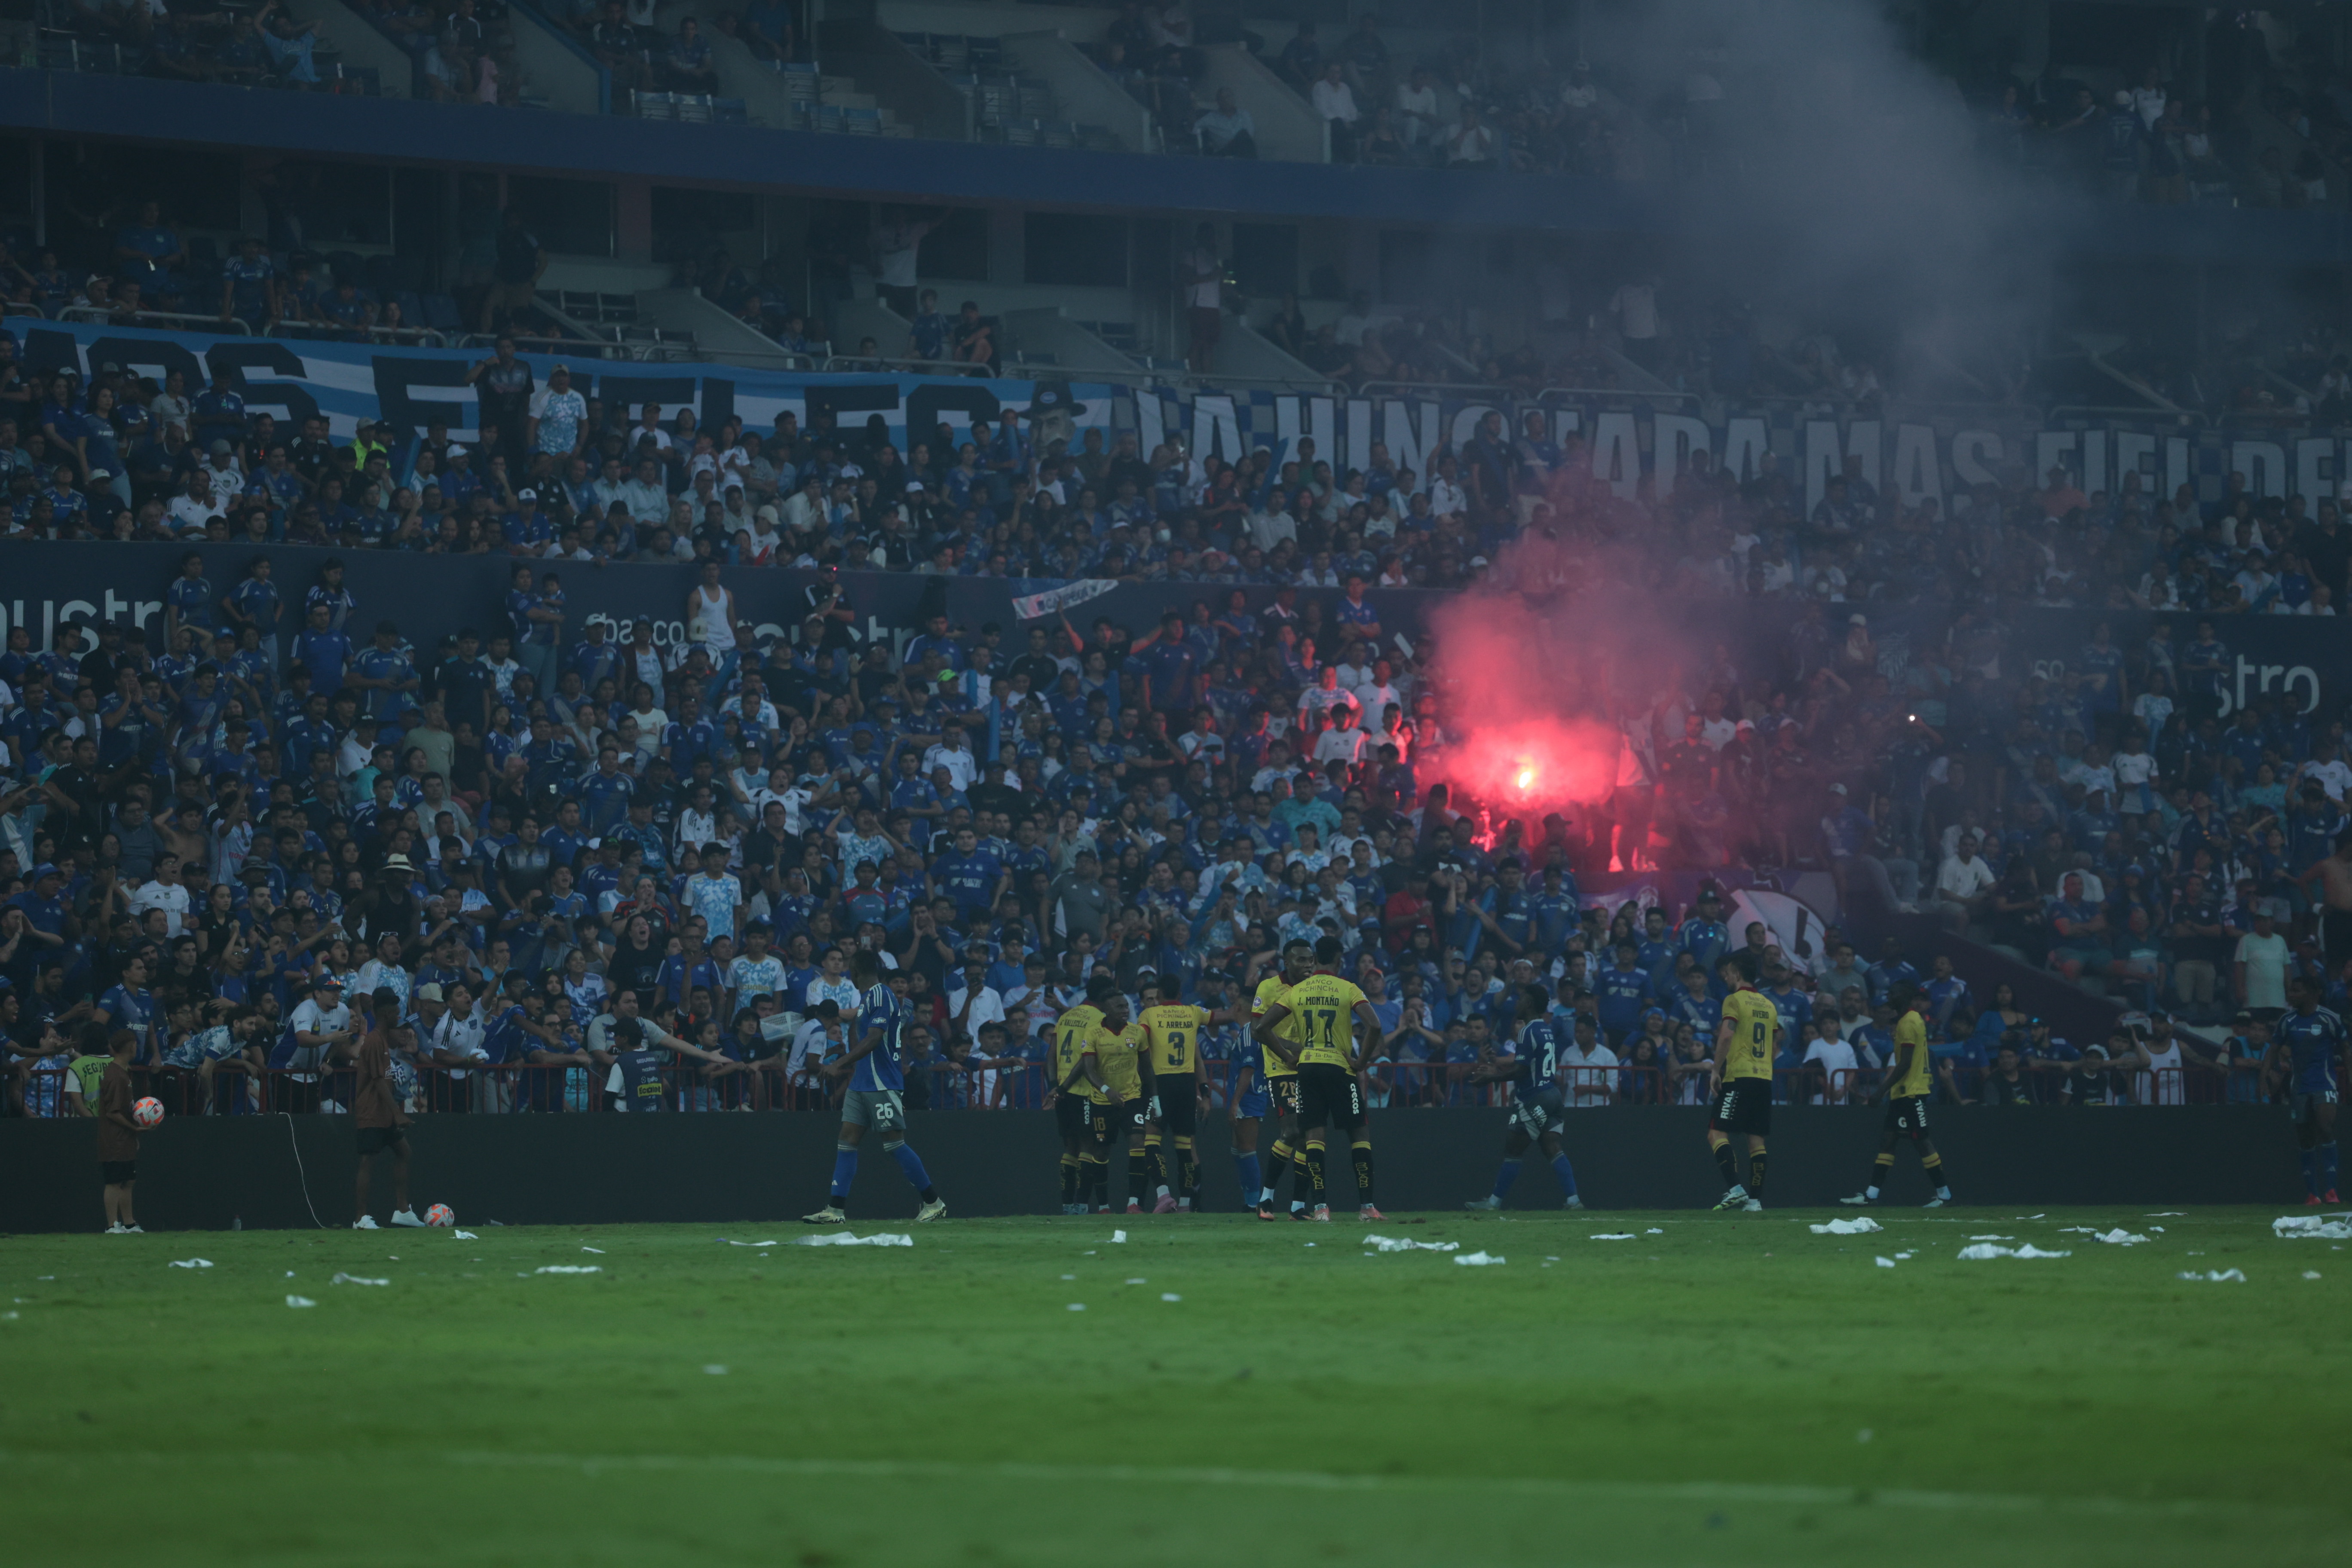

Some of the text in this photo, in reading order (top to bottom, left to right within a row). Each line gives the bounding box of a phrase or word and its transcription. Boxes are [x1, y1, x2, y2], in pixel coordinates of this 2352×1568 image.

[1299, 985, 1339, 993] PICHINCHA
[1306, 995, 1339, 1006] MONTAÑO
[1303, 1009, 1336, 1048] 17
[1752, 1022, 1765, 1058] 9
[1060, 1029, 1074, 1063] 4
[1168, 1032, 1185, 1066] 3
[875, 1102, 894, 1120] 26
[1720, 1090, 1735, 1120] RIVAL
[1308, 1162, 1324, 1190] ROLAND
[1355, 1162, 1369, 1188] ROLAND
